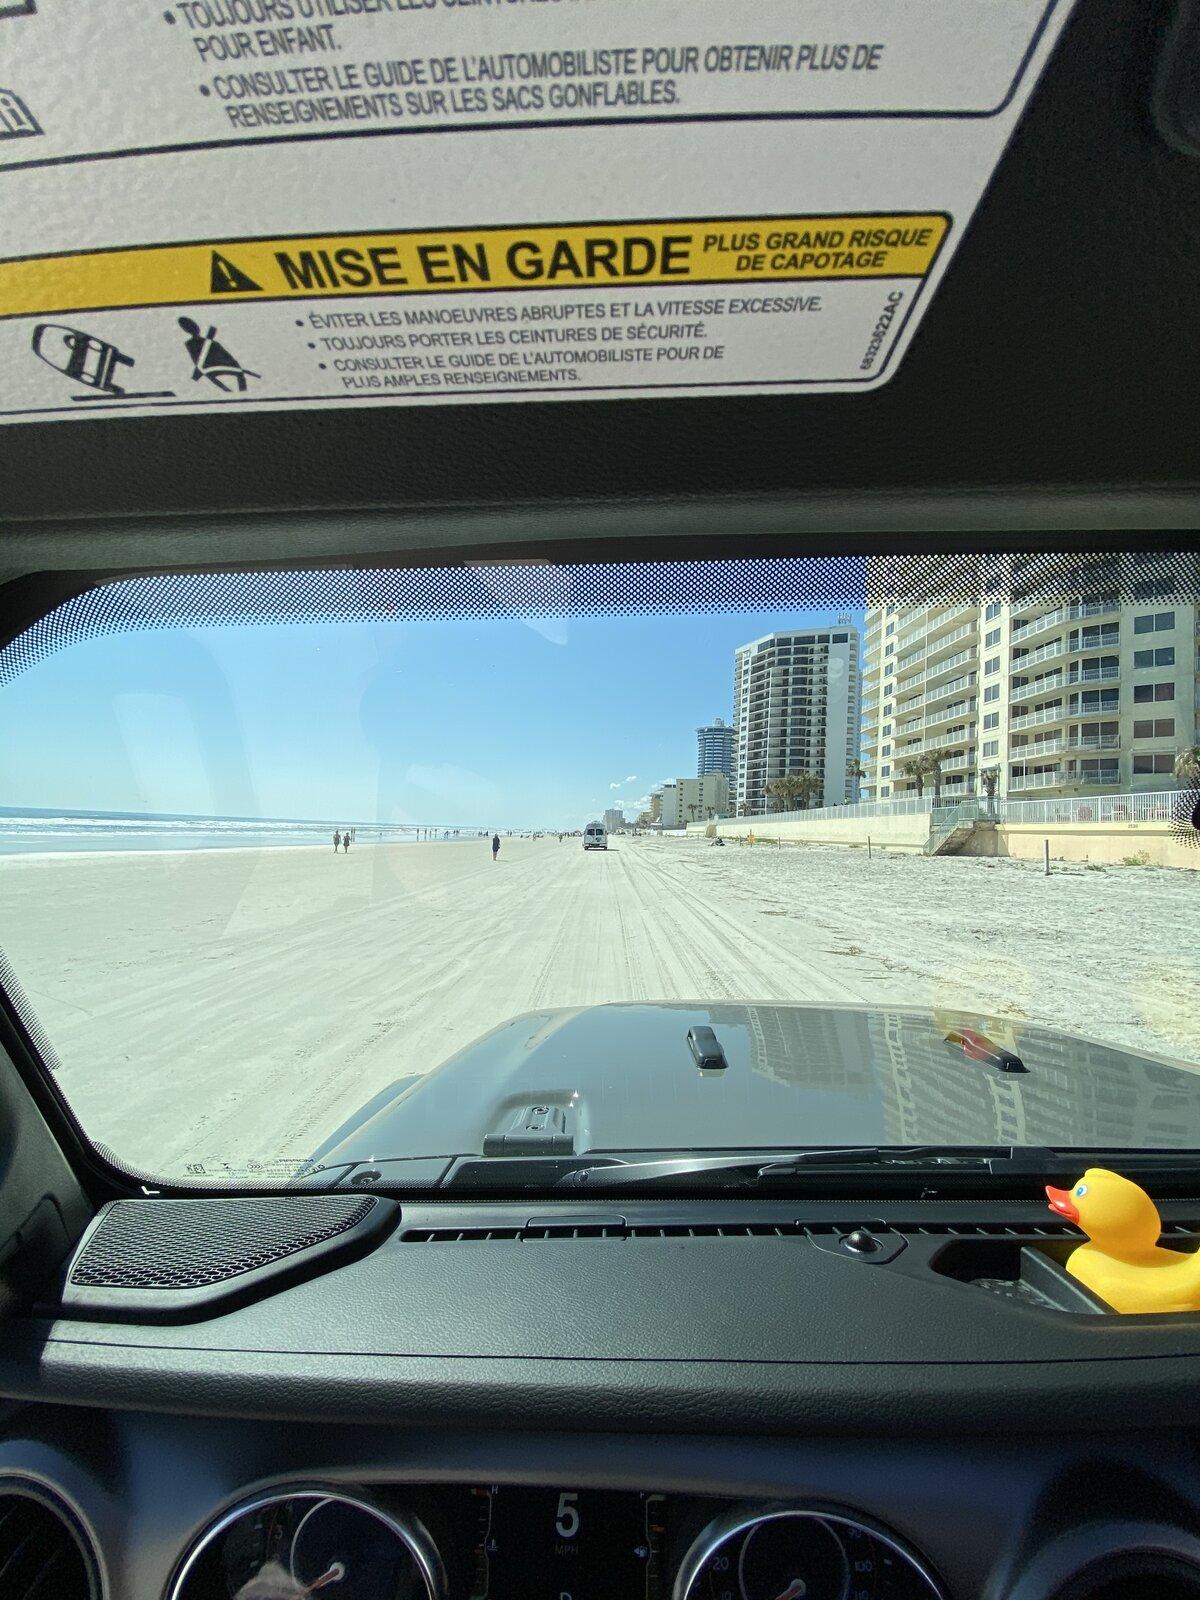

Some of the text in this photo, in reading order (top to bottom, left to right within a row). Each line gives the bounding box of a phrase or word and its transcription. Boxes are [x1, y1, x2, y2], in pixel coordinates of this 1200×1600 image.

[176, 0, 295, 29] TOUJOURS
[193, 24, 342, 62] POUR ENFANT.
[213, 44, 884, 100] CONSULTER LE GUIDE DE L'AUTOMOBILISTE POUR OBTENIR PLUS DE
[225, 78, 680, 128] RENSEIGNEMENTS SUR LES SACS GONFLABLES.
[703, 228, 933, 252] PLUS GRAND RISQUE
[274, 235, 692, 290] MISE EN GARDE
[736, 250, 888, 272] DE CAPOTAGE
[308, 296, 822, 330] ÉVITER LES MANOEUVRES ABRUPTES ET LA VITESSE EXCESSIVE.
[320, 321, 707, 351] TOUJOURS PORTER LES CEINTURES DE SÉCURITÉ.
[333, 345, 724, 372] CONSULTER LE GUIDE DE L'AUTOMOBILISTE POUR DE
[342, 368, 581, 389] PLUS AMPLES RENSEIGNEMENTS.
[555, 1492, 580, 1538] 5
[554, 1544, 579, 1556] MPH
